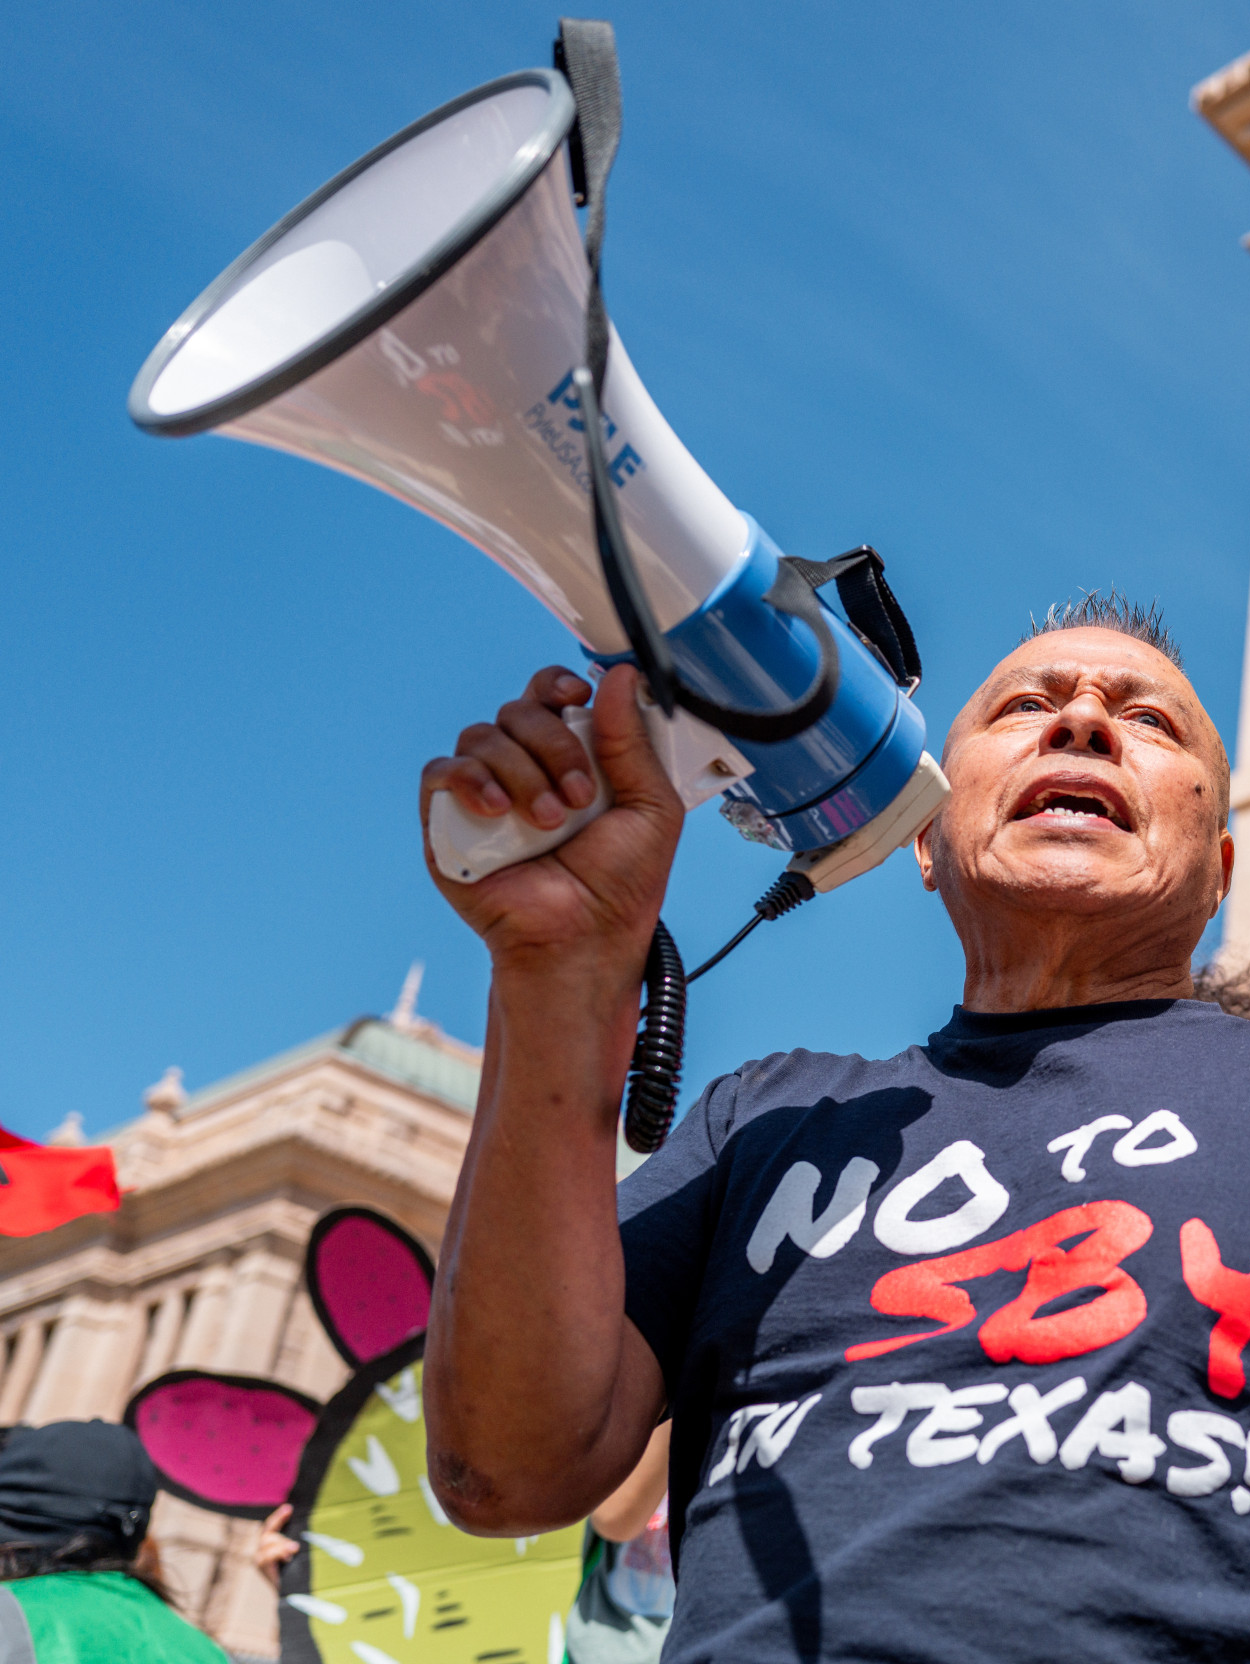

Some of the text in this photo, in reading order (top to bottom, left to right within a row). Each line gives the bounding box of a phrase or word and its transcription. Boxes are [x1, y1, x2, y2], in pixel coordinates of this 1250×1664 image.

[524, 402, 594, 494] PyleUSA.co
[547, 368, 643, 489] PE
[746, 1109, 1198, 1274] NO TO
[708, 1394, 822, 1487] IN
